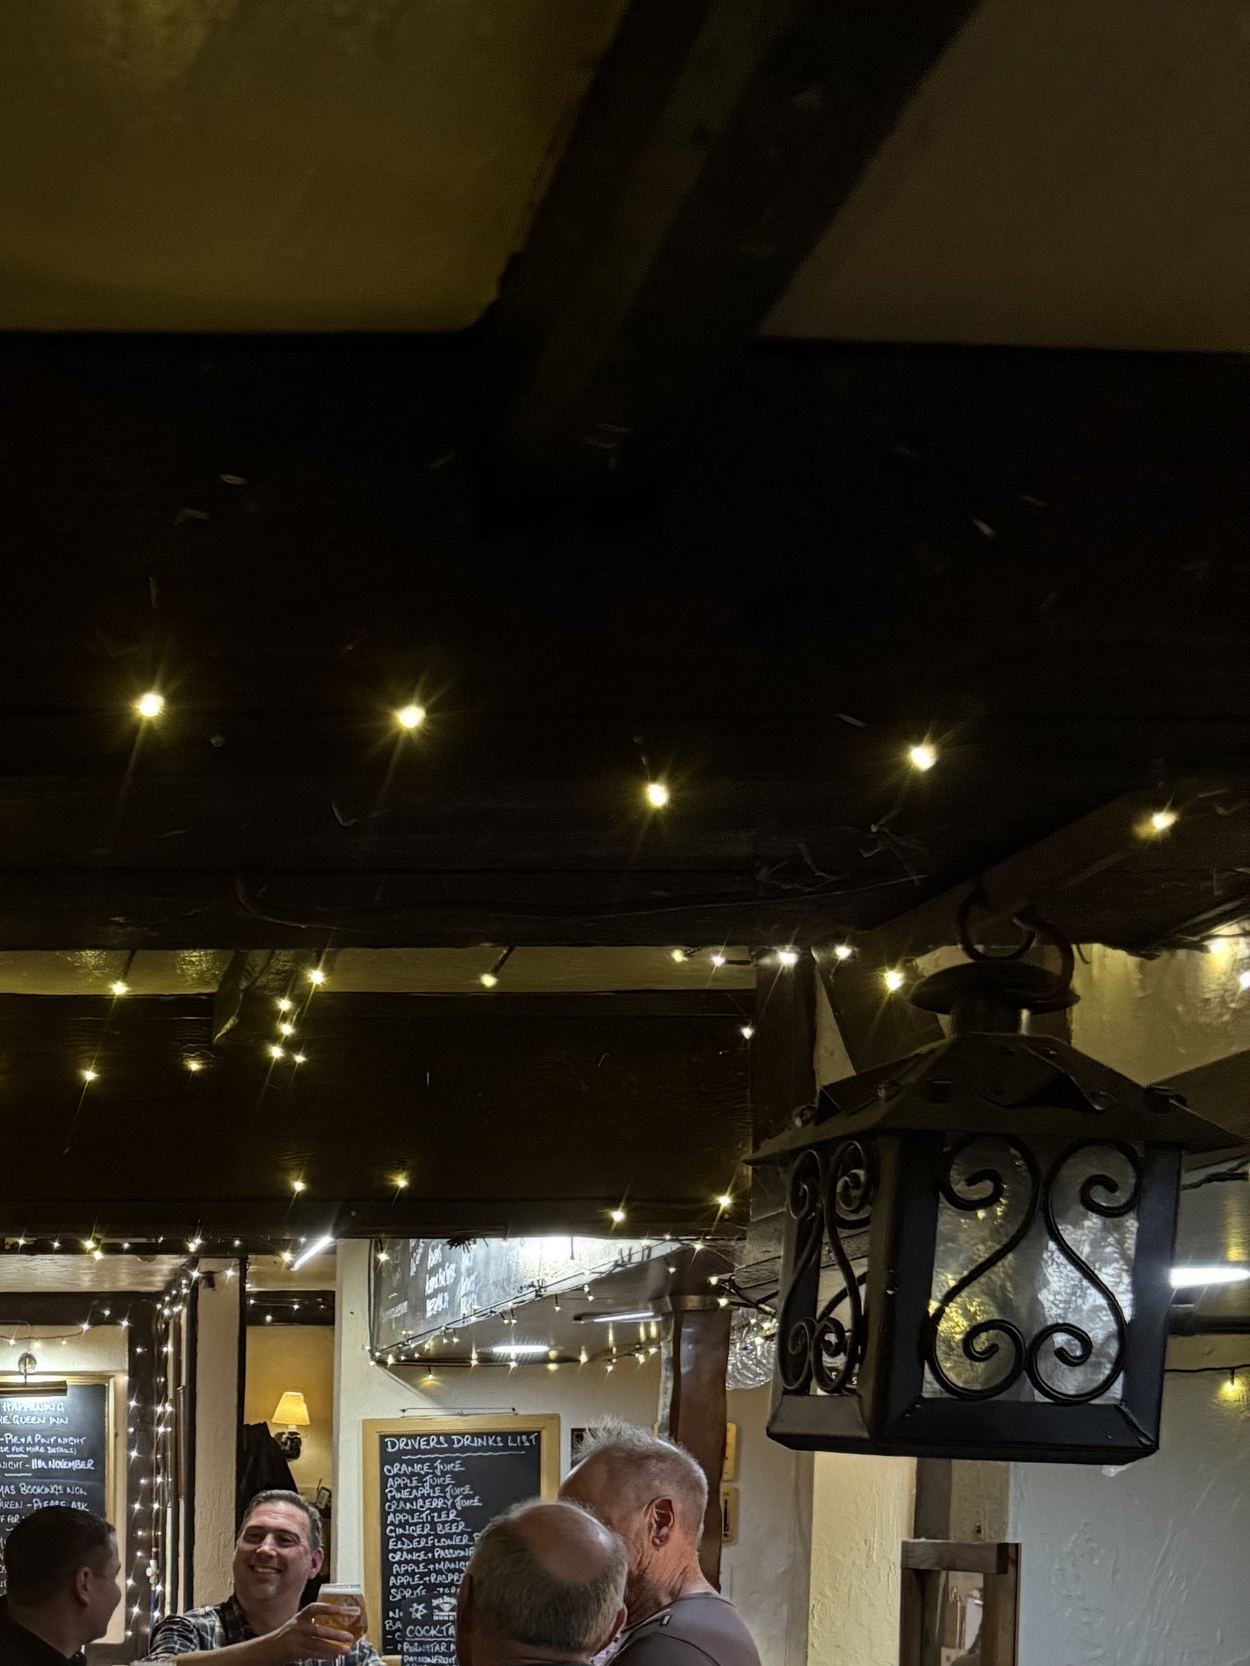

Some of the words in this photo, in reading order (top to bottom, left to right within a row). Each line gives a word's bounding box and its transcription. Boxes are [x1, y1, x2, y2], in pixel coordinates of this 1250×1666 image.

[12, 1414, 46, 1426] QUEEN
[49, 1416, 69, 1425] INN
[35, 1434, 56, 1445] PINT
[58, 1436, 87, 1446] NIGHT
[384, 1435, 449, 1452] DRIVERS
[452, 1434, 502, 1448] DRINKS
[508, 1433, 538, 1447] LIST
[0, 1460, 24, 1470] NIGHT
[48, 1458, 95, 1470] NOVEMBER
[384, 1462, 433, 1476] ORANGE
[434, 1459, 466, 1475] JUICE
[386, 1476, 422, 1488] APPLE
[423, 1474, 456, 1489] JUICE
[19, 1482, 64, 1495] BOOKINGS
[66, 1486, 88, 1496] NOW
[385, 1487, 444, 1500] PINEAPPLE
[445, 1485, 473, 1499] JUICE
[71, 1501, 91, 1512] ASK
[385, 1498, 453, 1512] CRANBERRY
[454, 1496, 483, 1510] JUICE
[7, 1514, 21, 1523] FOR
[387, 1510, 461, 1525] APPLETIZER
[386, 1525, 435, 1537] GINGER
[436, 1521, 472, 1534] BEER
[388, 1533, 473, 1549] ELDERFLOWER
[388, 1551, 427, 1562] ORANGE
[393, 1562, 428, 1574] APPLE
[389, 1574, 424, 1586] APPLE
[389, 1586, 427, 1601] SPRITE
[406, 1623, 456, 1637] COCKTA
